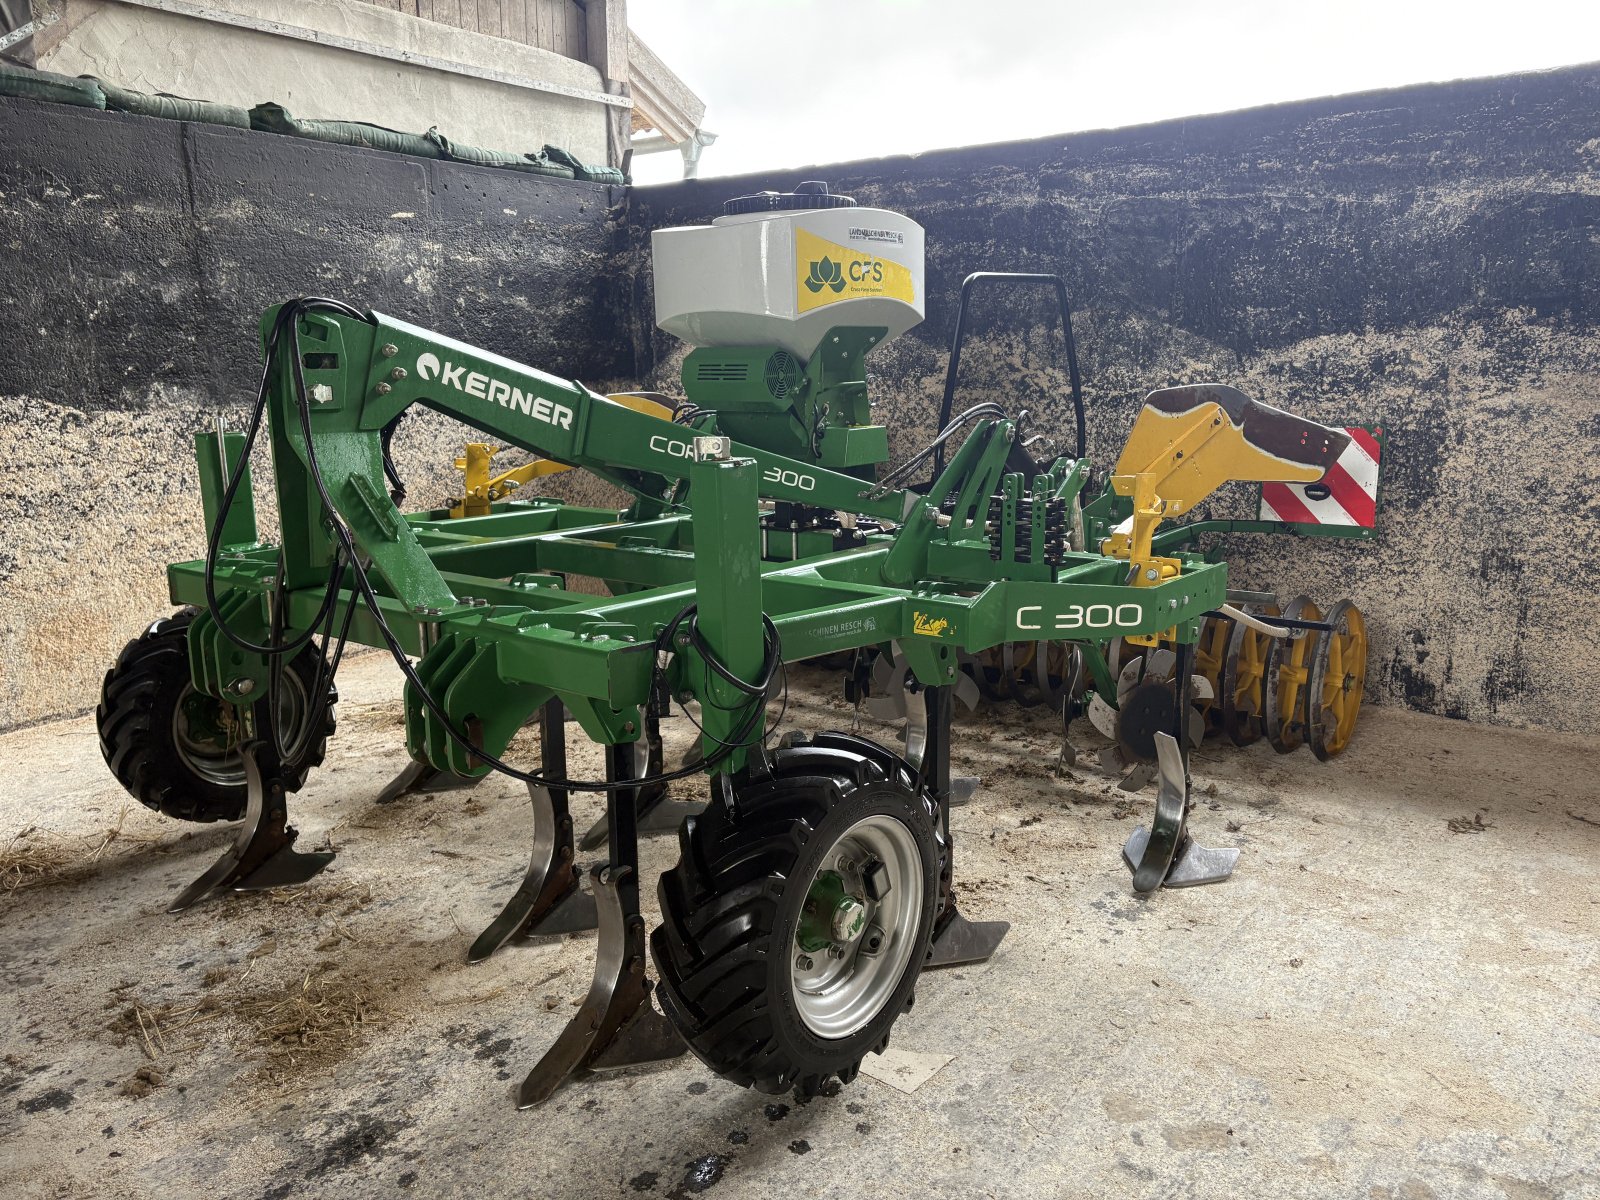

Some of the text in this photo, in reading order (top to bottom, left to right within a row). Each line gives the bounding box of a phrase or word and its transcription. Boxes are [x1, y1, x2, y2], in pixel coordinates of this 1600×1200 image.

[848, 260, 883, 283] CFS
[441, 361, 574, 431] KERNER
[762, 466, 816, 491] 300
[1016, 603, 1143, 630] C 300
